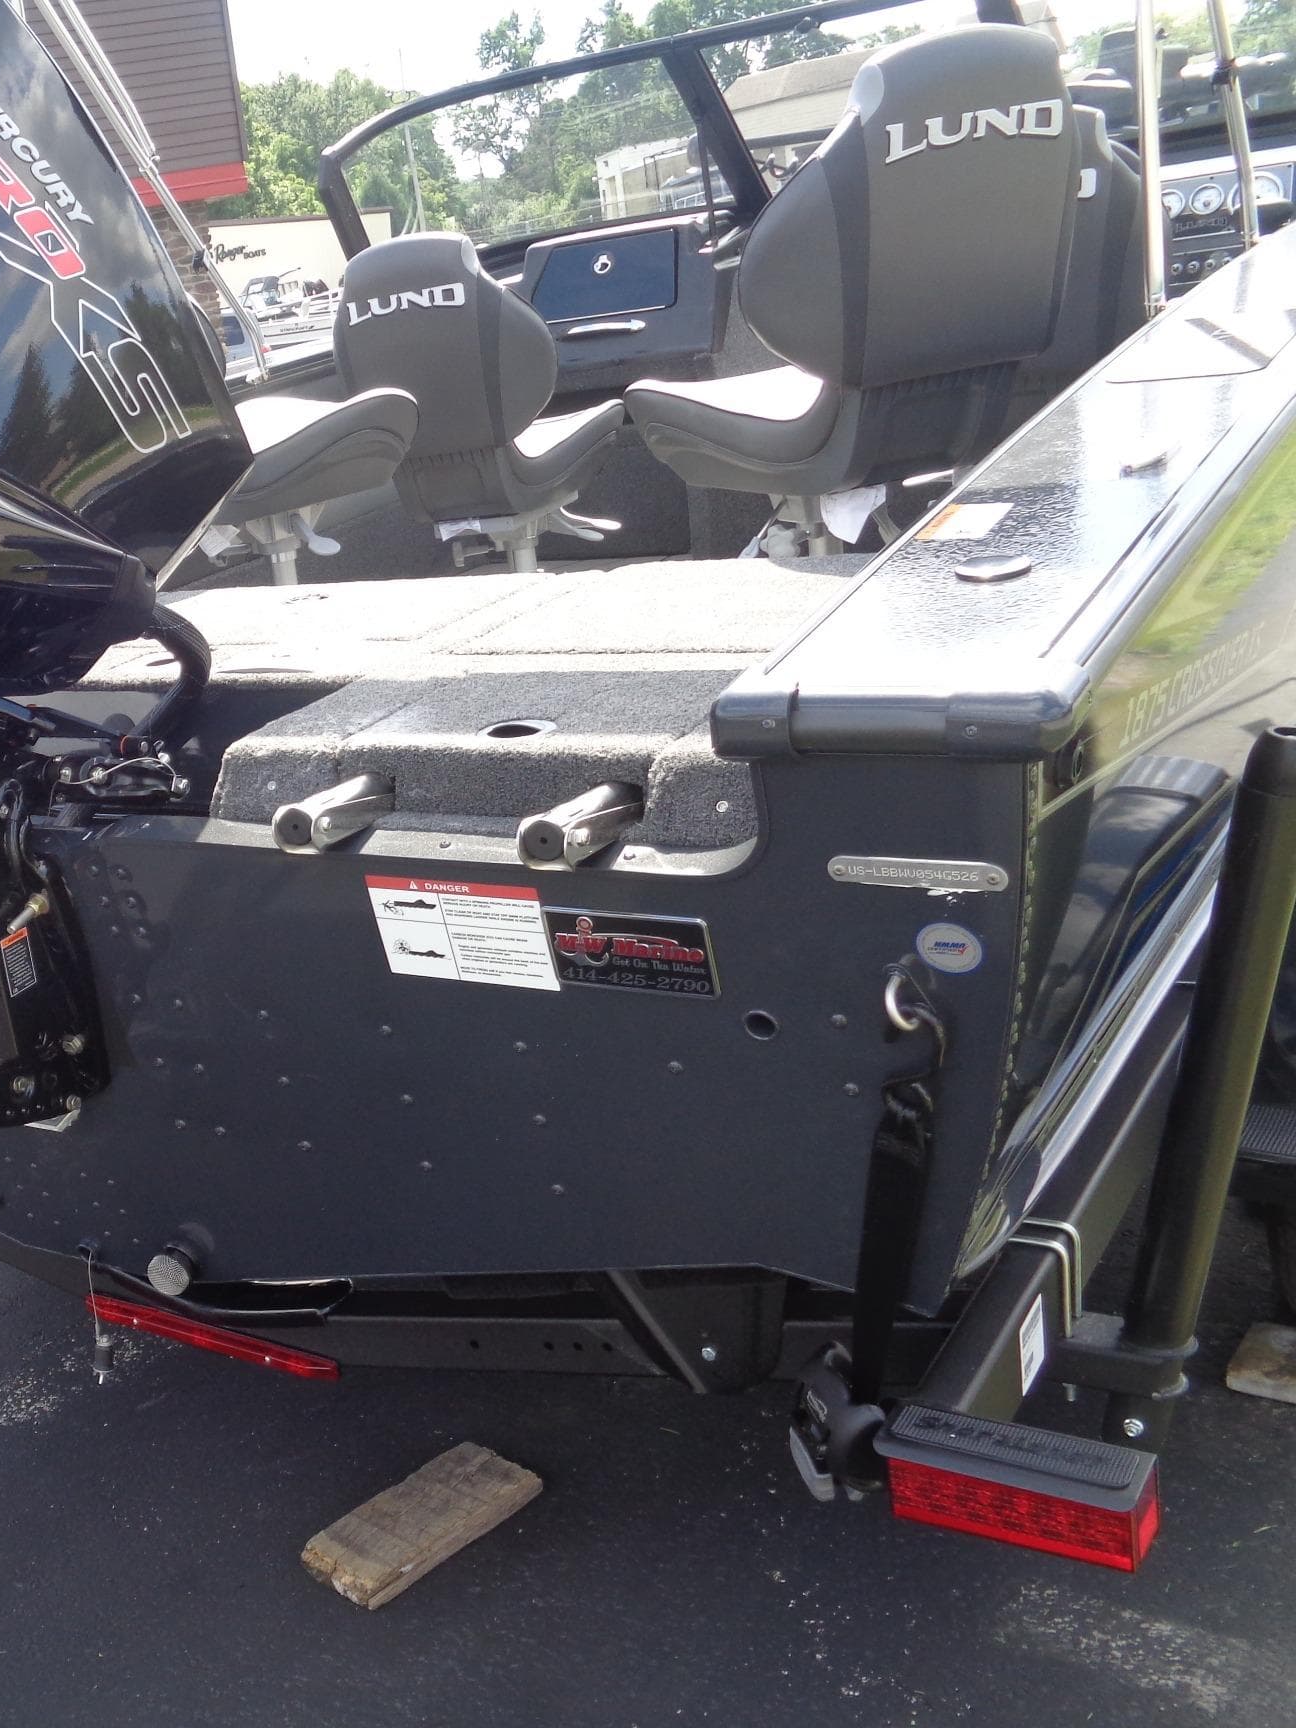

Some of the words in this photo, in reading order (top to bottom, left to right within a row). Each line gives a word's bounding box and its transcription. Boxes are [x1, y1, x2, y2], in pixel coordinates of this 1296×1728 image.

[885, 99, 1063, 164] LUND
[214, 243, 247, 265] Ranger
[243, 248, 267, 260] BOATS
[346, 283, 466, 326] LUND
[1119, 677, 1171, 749] 1875
[424, 882, 470, 894] DANGER
[612, 937, 705, 963] Marine
[563, 966, 710, 993] 414-425-2790
